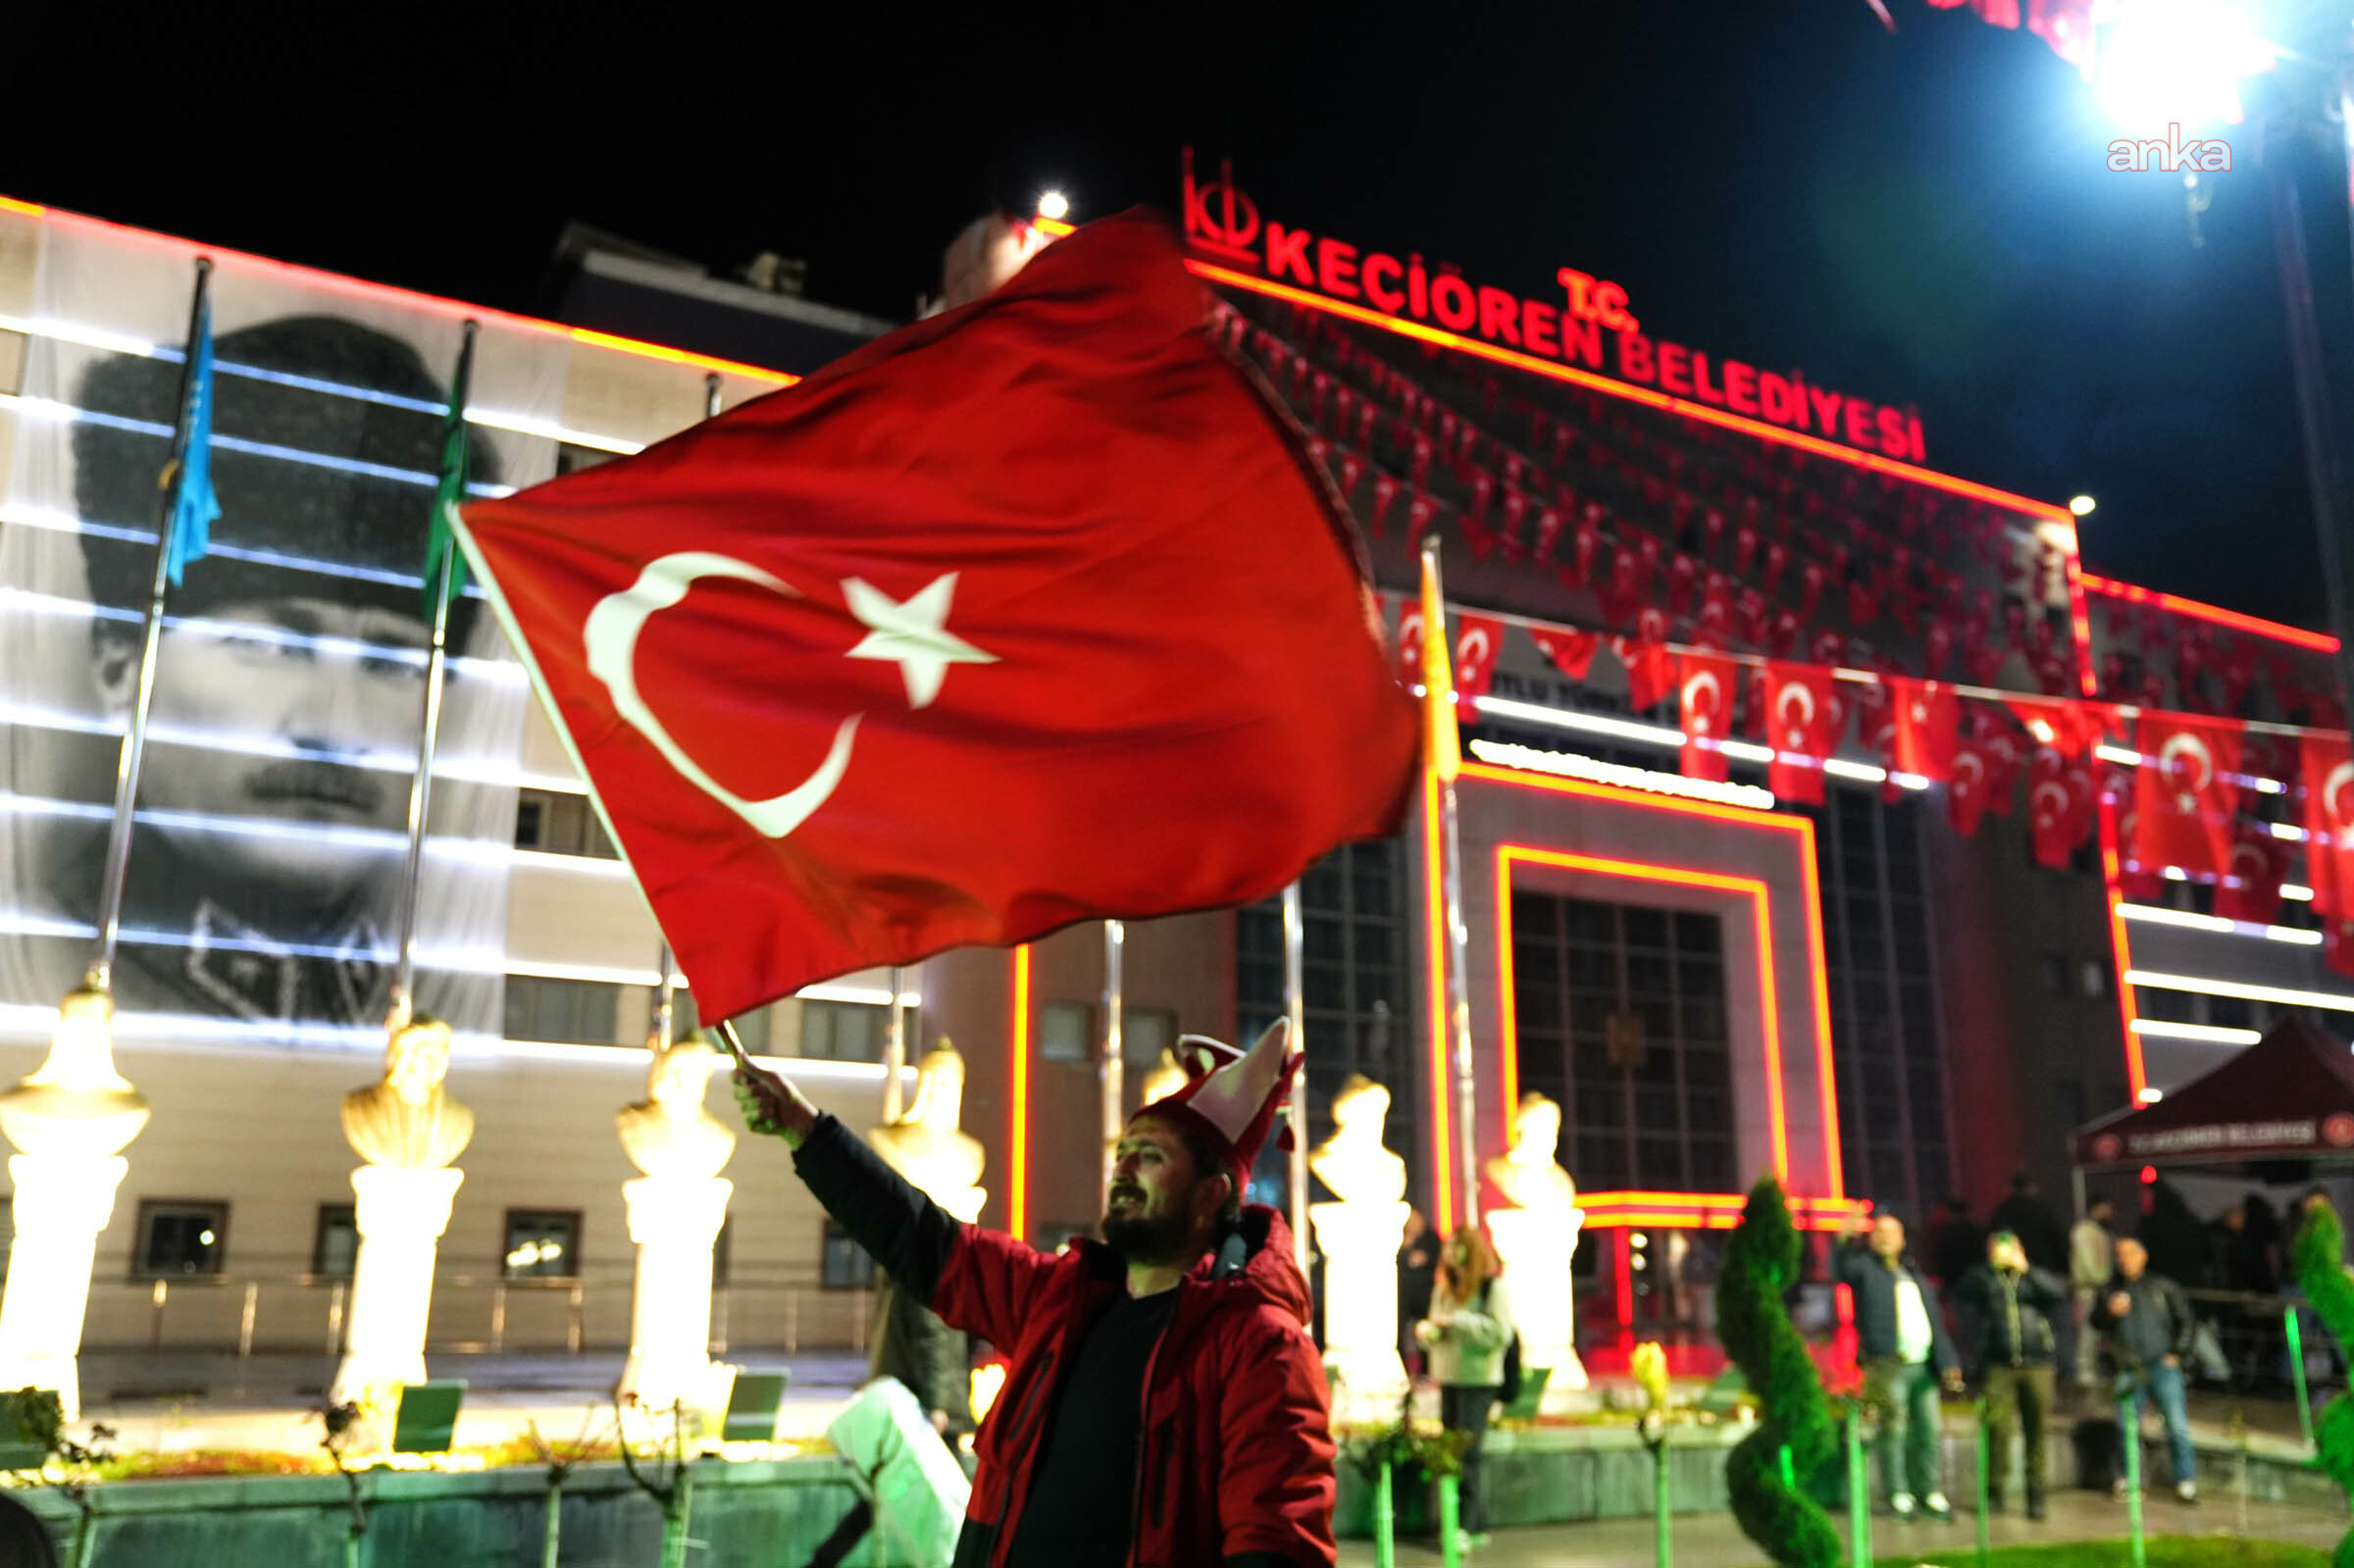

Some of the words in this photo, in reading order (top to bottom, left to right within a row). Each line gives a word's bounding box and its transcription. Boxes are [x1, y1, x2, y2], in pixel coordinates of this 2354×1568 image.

[1266, 222, 1604, 370] KEÇİÖREN
[1617, 331, 1925, 462] BELEDİYESİ
[1558, 267, 1639, 334] T.C.
